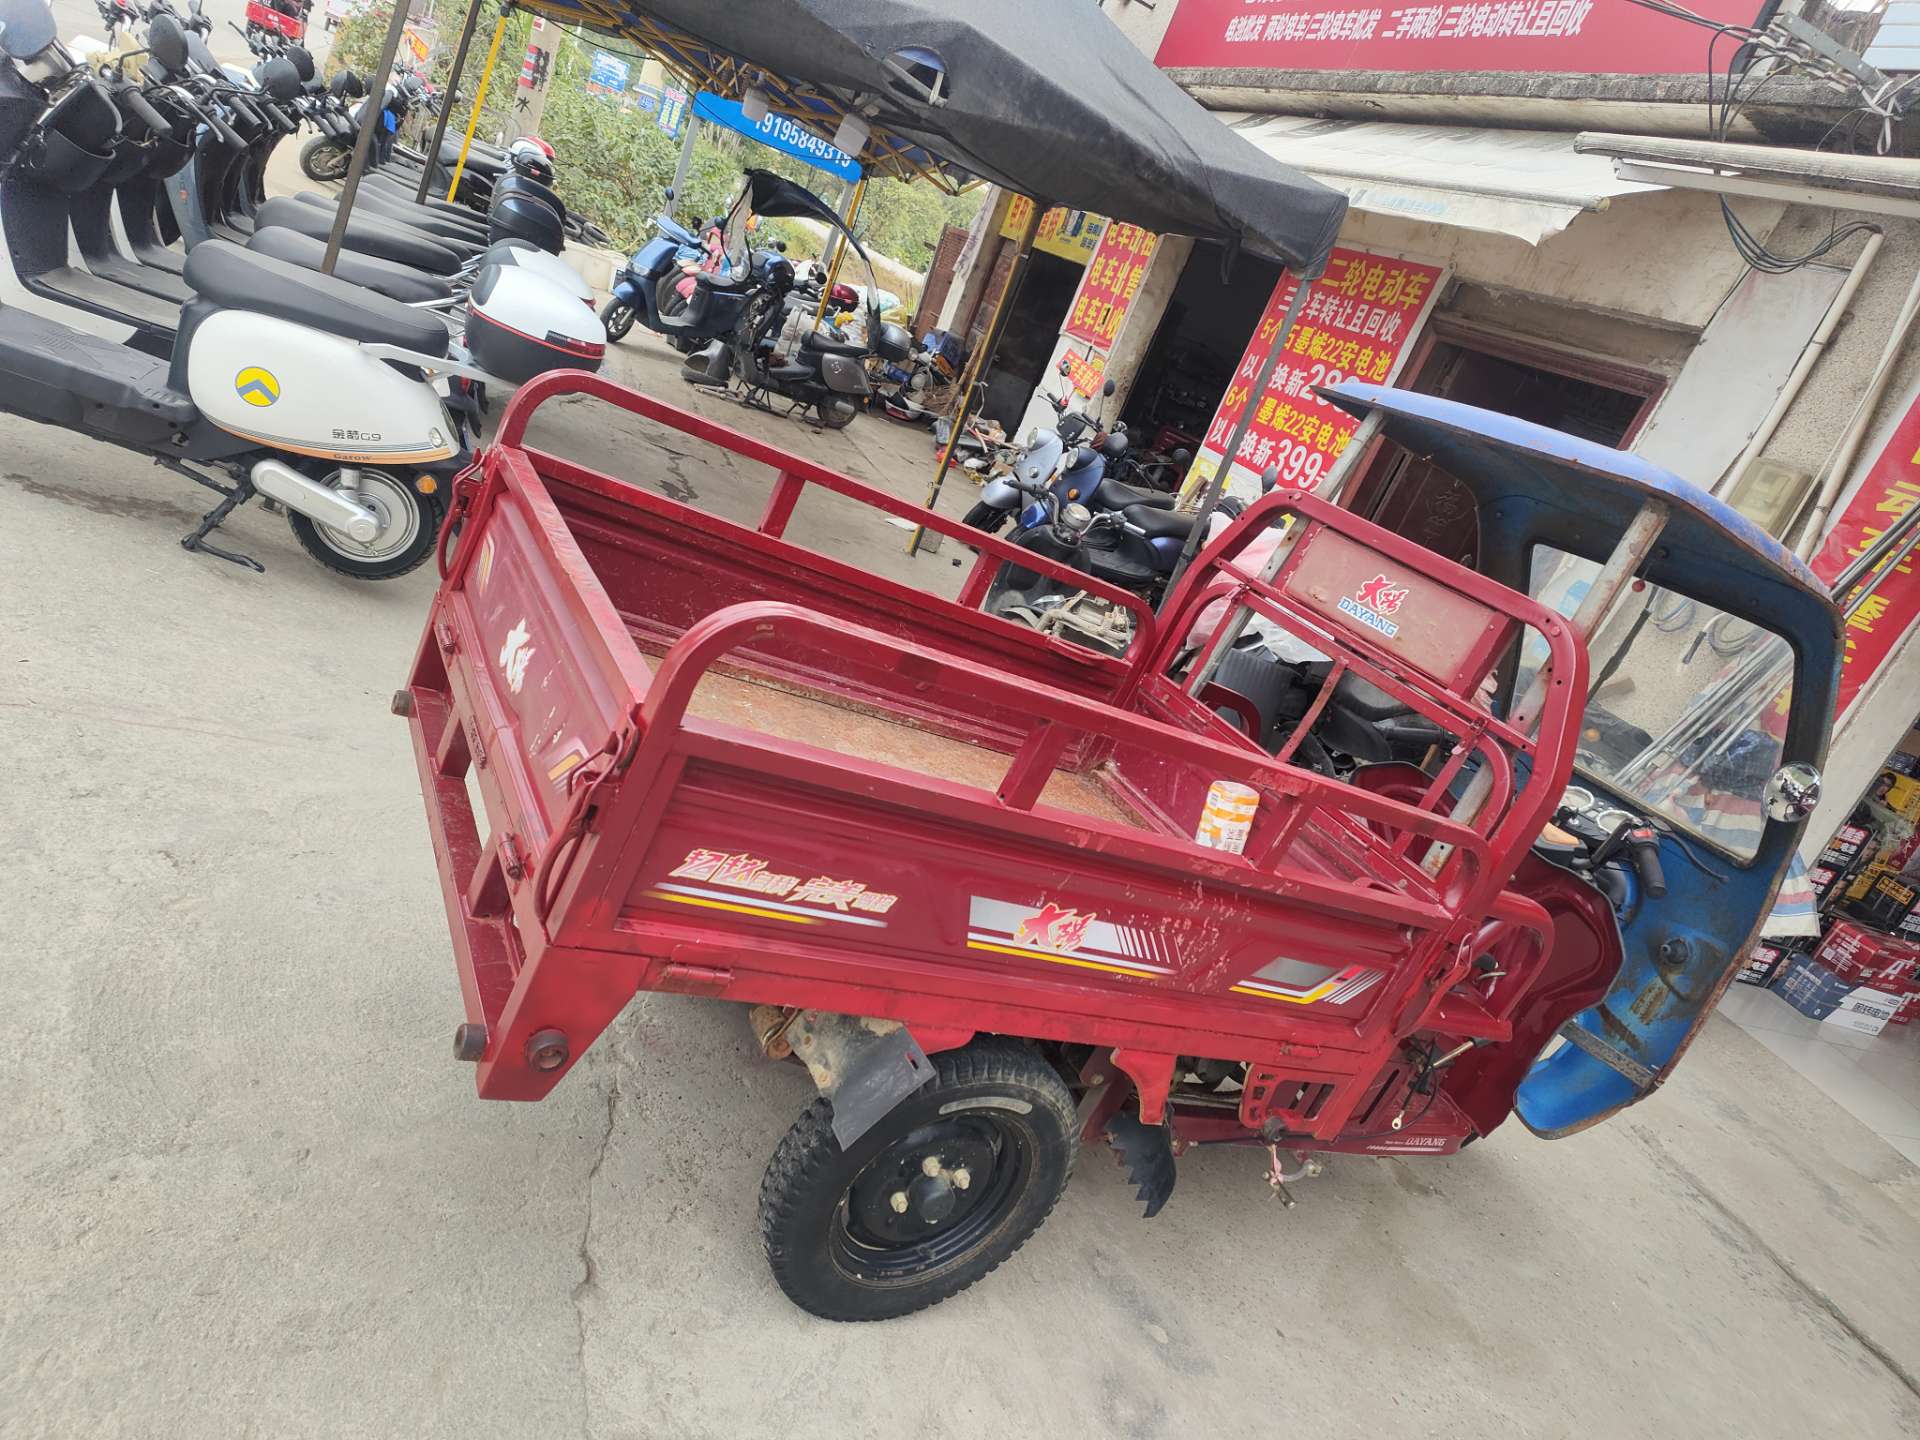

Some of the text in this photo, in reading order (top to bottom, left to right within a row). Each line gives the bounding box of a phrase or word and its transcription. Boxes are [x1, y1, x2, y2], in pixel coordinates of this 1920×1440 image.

[1224, 15, 1266, 42] 电池批发
[1090, 252, 1144, 300] 电车出售
[1074, 293, 1125, 339] 电车回收
[1225, 385, 1352, 458] 6个墨烯22安电池
[1339, 597, 1398, 636] DAYANG
[1404, 1136, 1448, 1147] DAYANG
